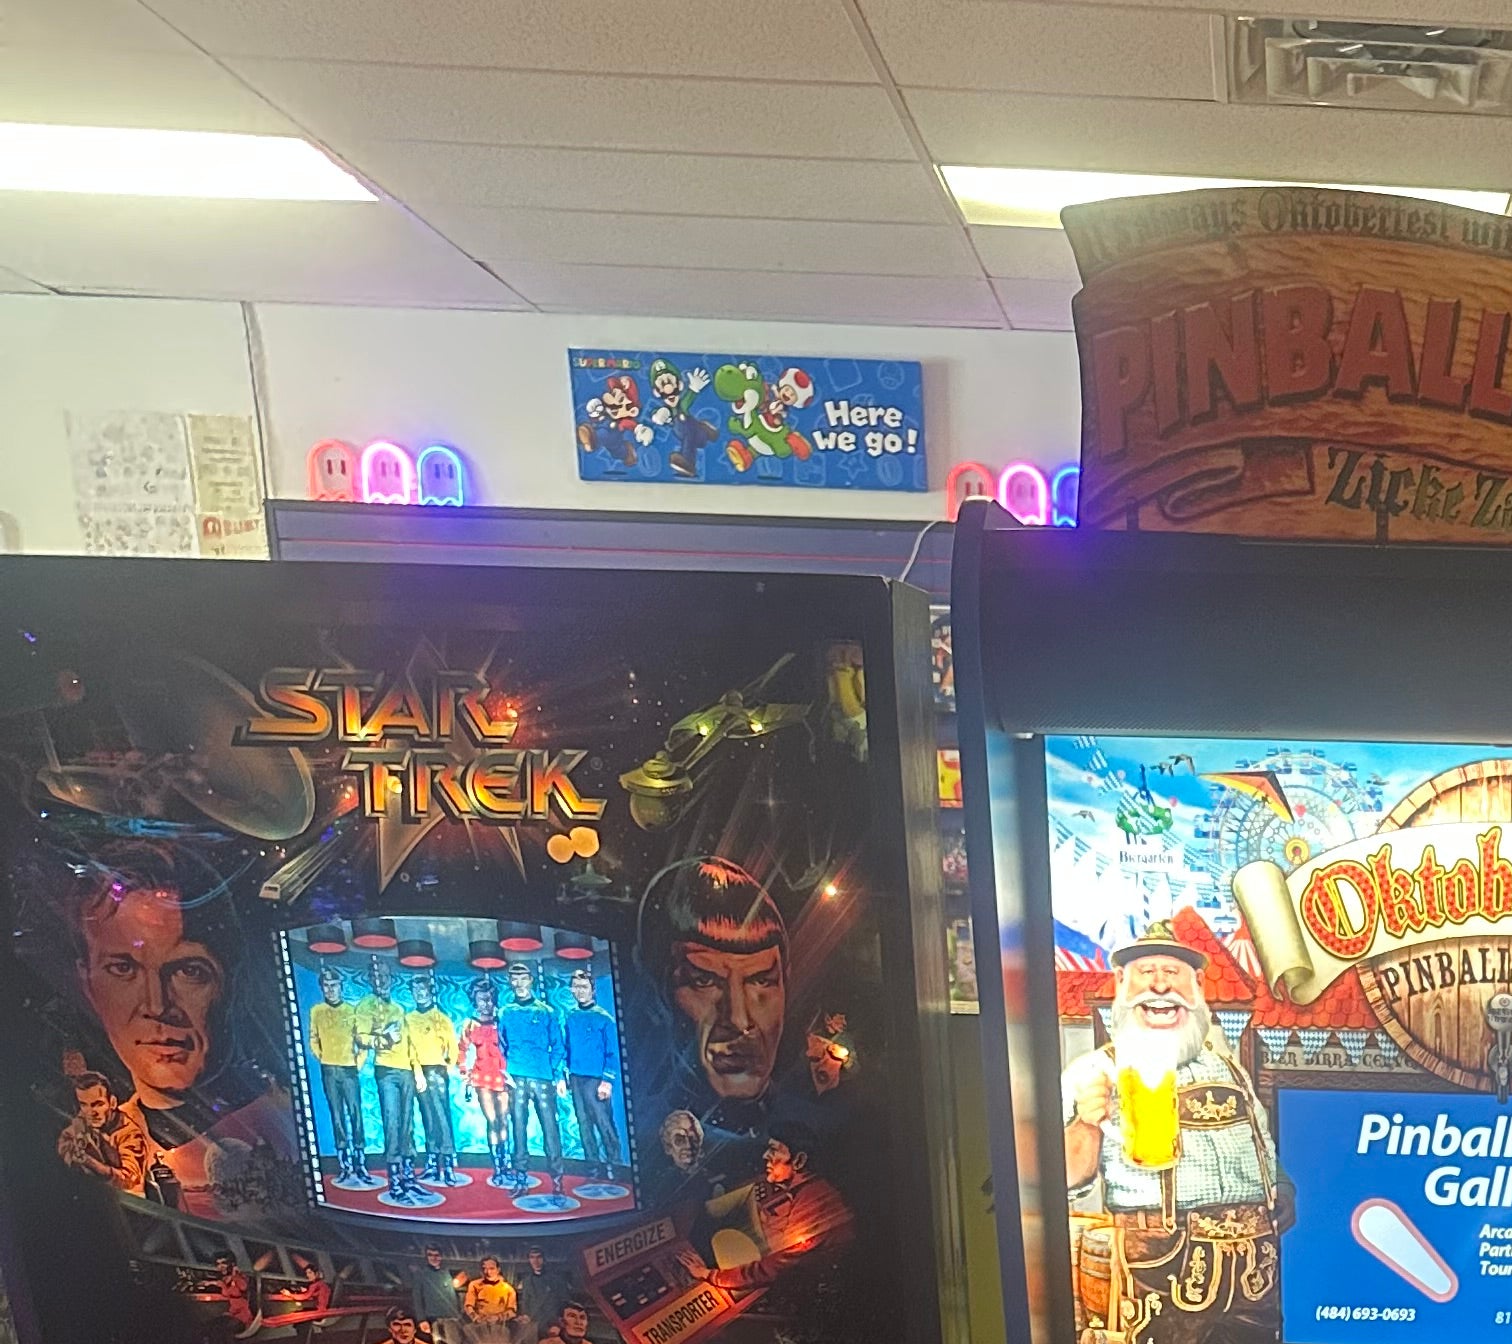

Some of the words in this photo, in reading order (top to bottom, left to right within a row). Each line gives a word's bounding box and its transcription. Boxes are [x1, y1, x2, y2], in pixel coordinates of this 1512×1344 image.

[572, 357, 607, 369] SUPER
[607, 358, 641, 370] MARIO
[823, 400, 904, 429] Here
[812, 429, 857, 453] we
[864, 428, 918, 457] go!
[1325, 447, 1466, 522] Zicke
[233, 668, 521, 748] STAR
[343, 748, 606, 826] TREK
[1383, 947, 1512, 1008] PINBALL
[595, 1221, 667, 1268] ENERGIZE
[1315, 1306, 1351, 1322] (484)
[1352, 1306, 1416, 1322] 693-0693
[1495, 1312, 1511, 1325] 81
